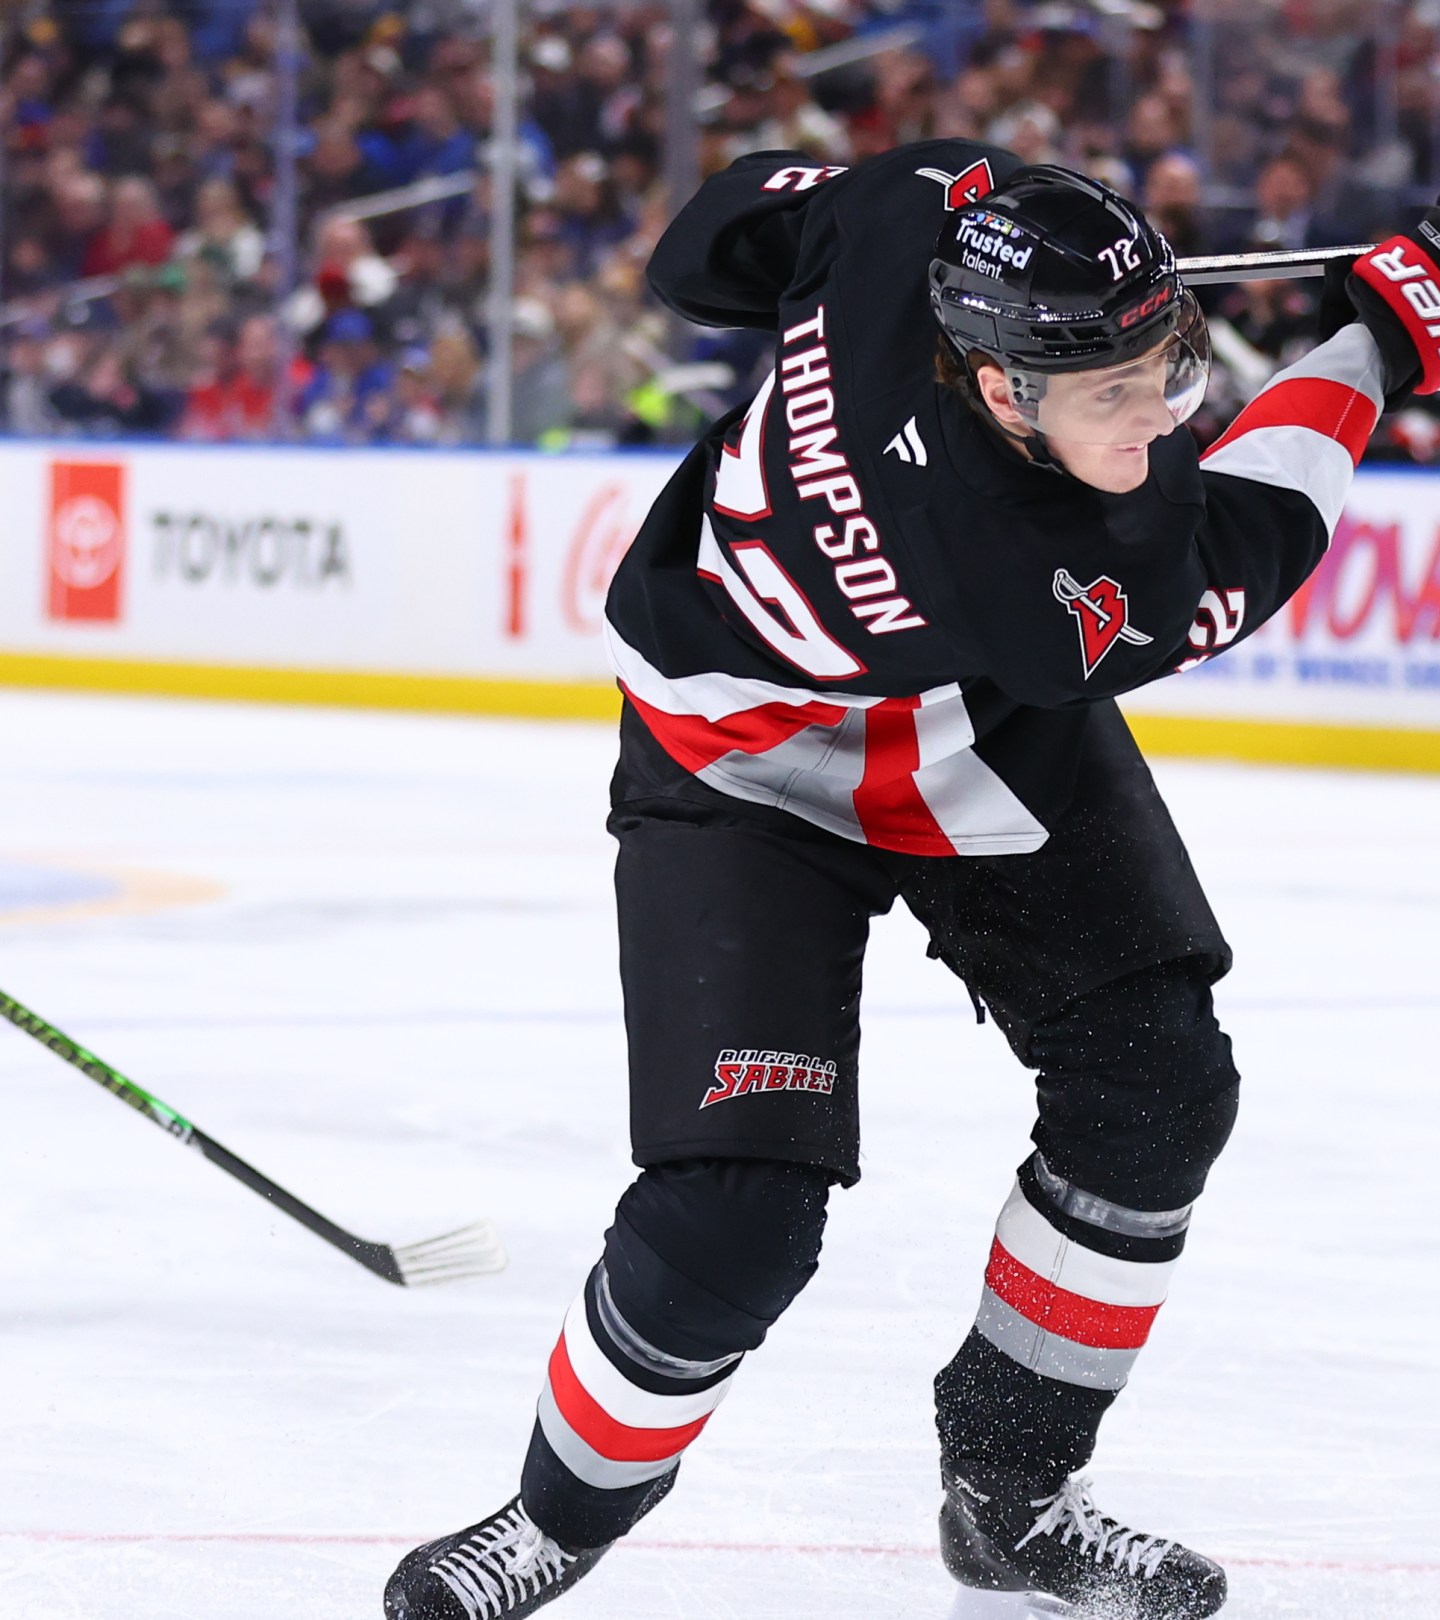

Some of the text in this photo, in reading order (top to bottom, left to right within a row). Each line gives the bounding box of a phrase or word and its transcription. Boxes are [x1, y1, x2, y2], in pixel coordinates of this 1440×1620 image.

[955, 218, 1033, 271] Trusted
[962, 249, 1003, 281] talent
[1098, 238, 1141, 282] 72
[1121, 287, 1172, 328] CCM
[781, 304, 929, 635] THOMPSON
[152, 512, 351, 587] TOYOTA
[716, 1049, 837, 1075] BUFFALO
[699, 1063, 837, 1110] SABRES
